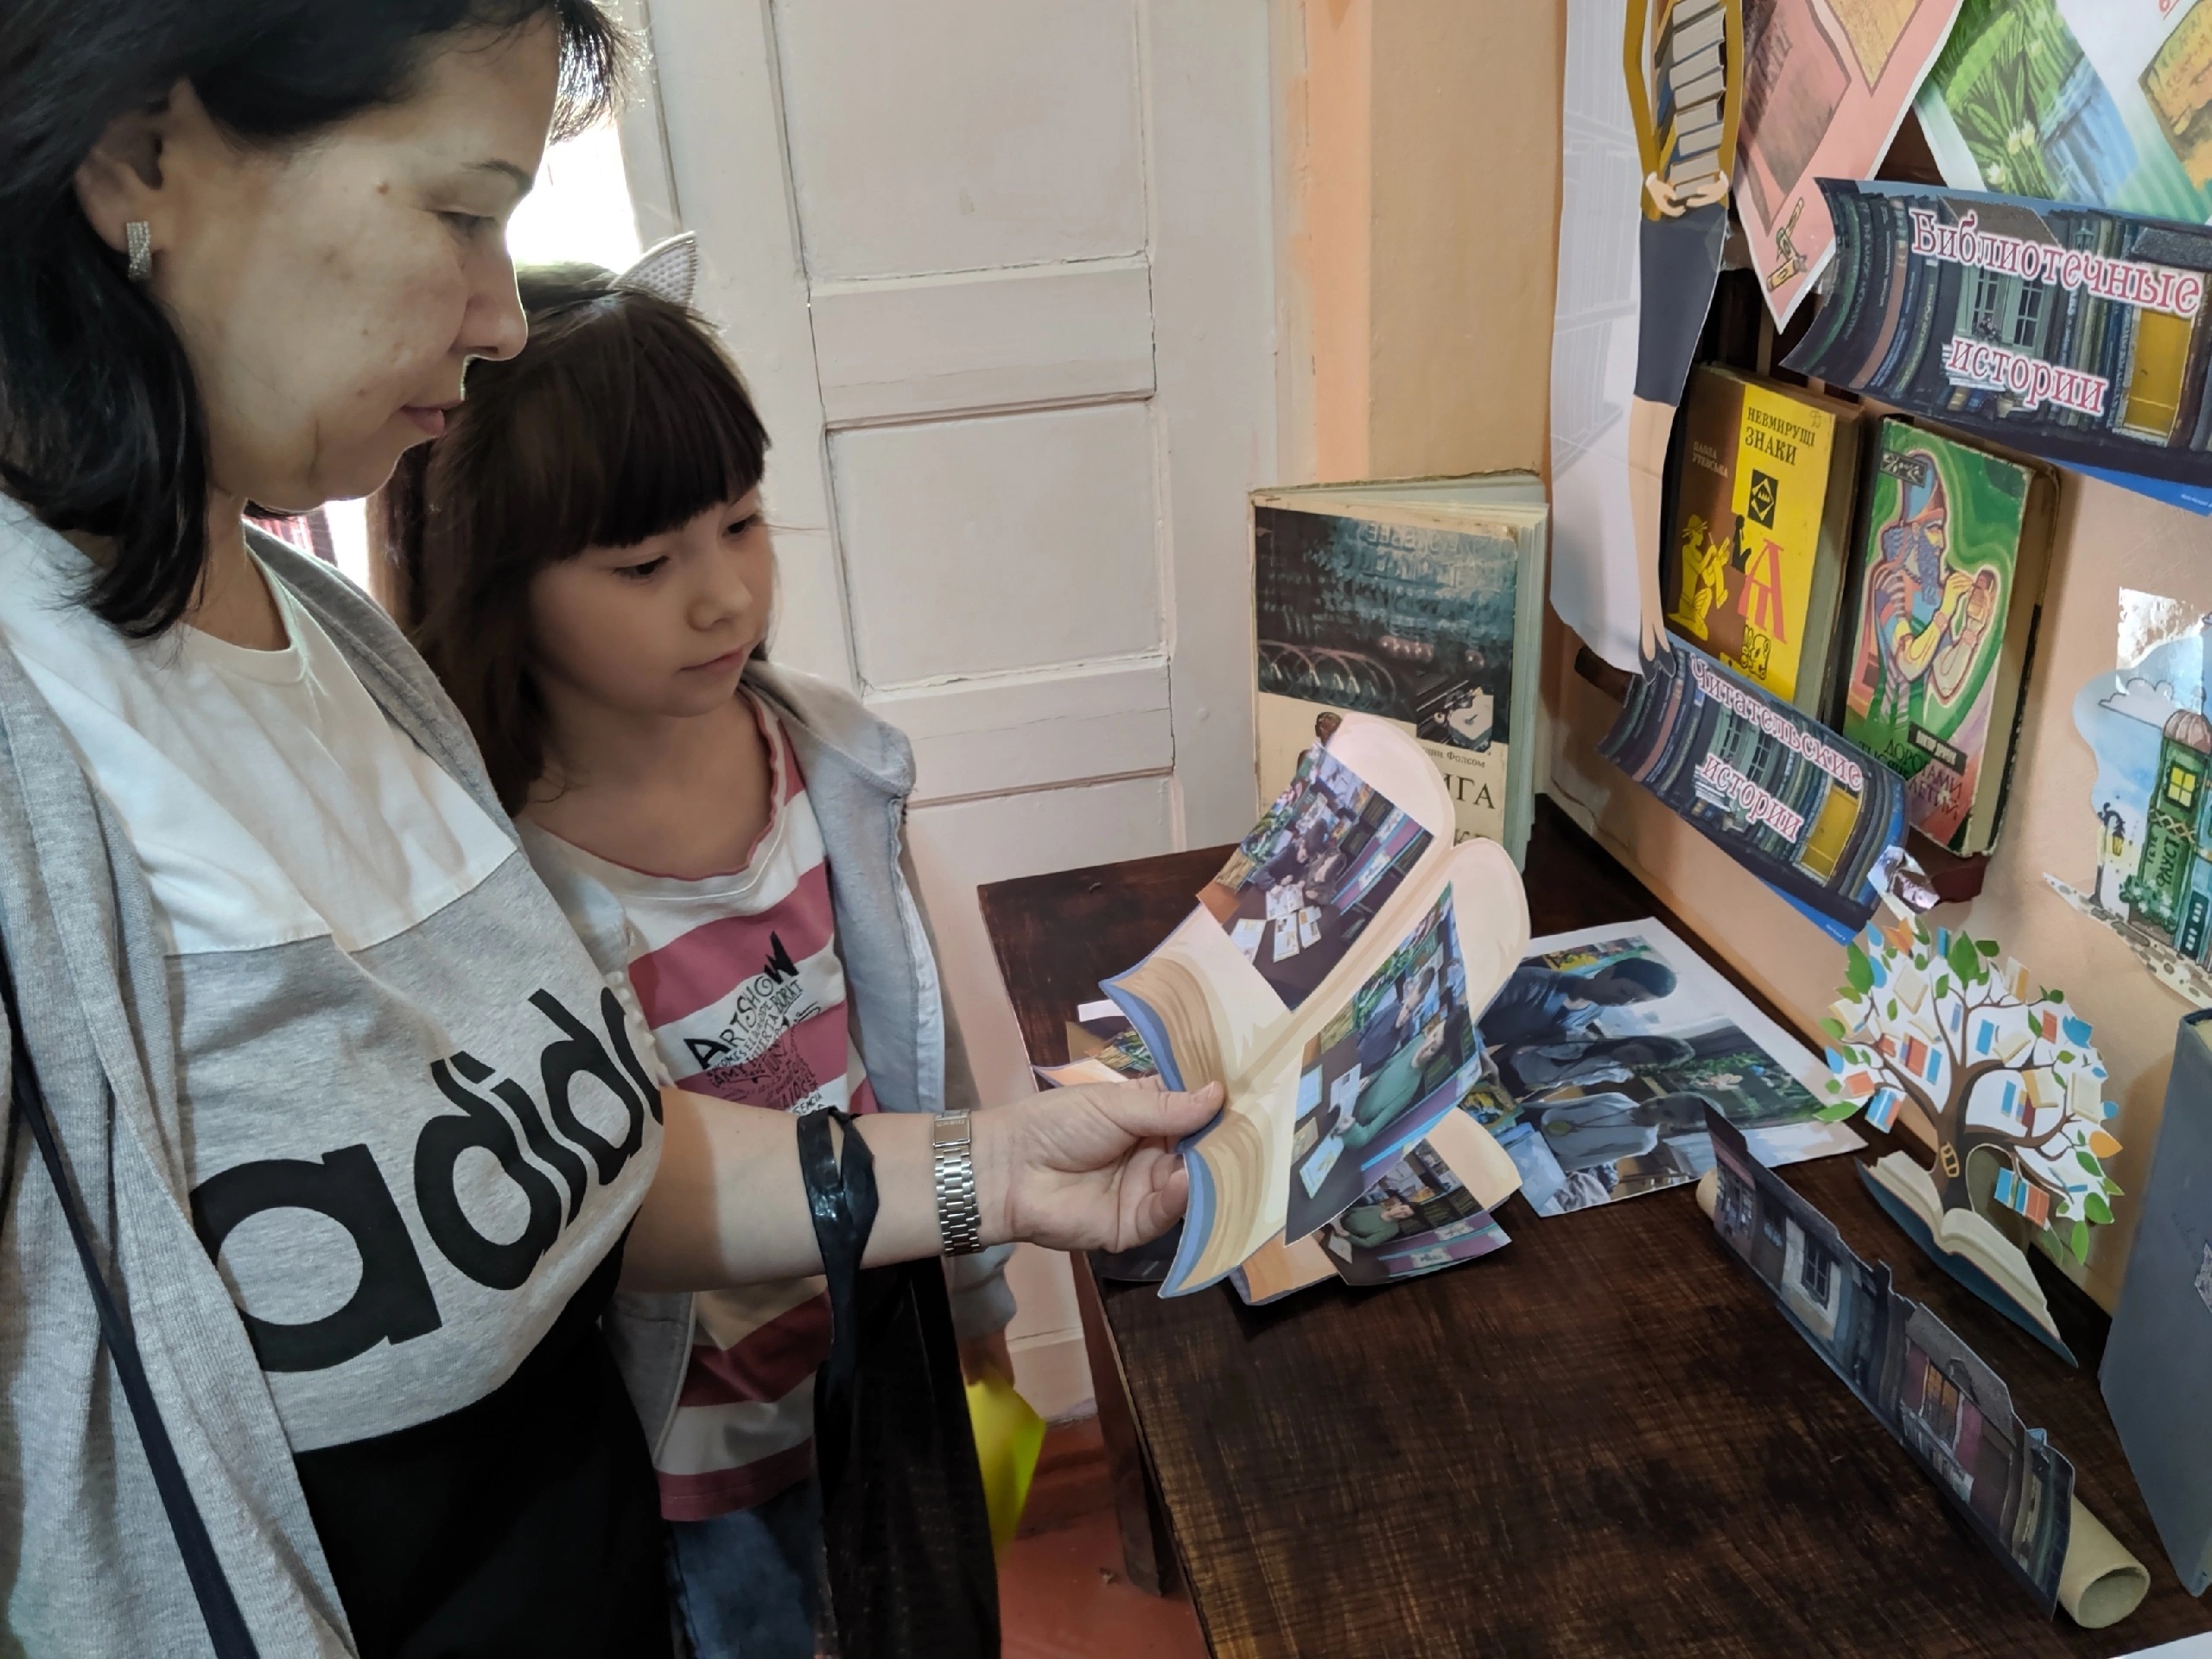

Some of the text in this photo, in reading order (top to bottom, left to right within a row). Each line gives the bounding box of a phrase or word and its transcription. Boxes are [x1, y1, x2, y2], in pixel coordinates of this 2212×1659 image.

[1910, 211, 2201, 315] Библиотечные
[1948, 339, 2107, 414] истории
[1745, 426, 1798, 467] ЗНАКИ
[1747, 406, 1816, 448] НЕВМИРУЩІ
[1691, 653, 1864, 790] Читательские
[1446, 751, 1485, 768] Фолсом
[1700, 753, 1805, 842] истории
